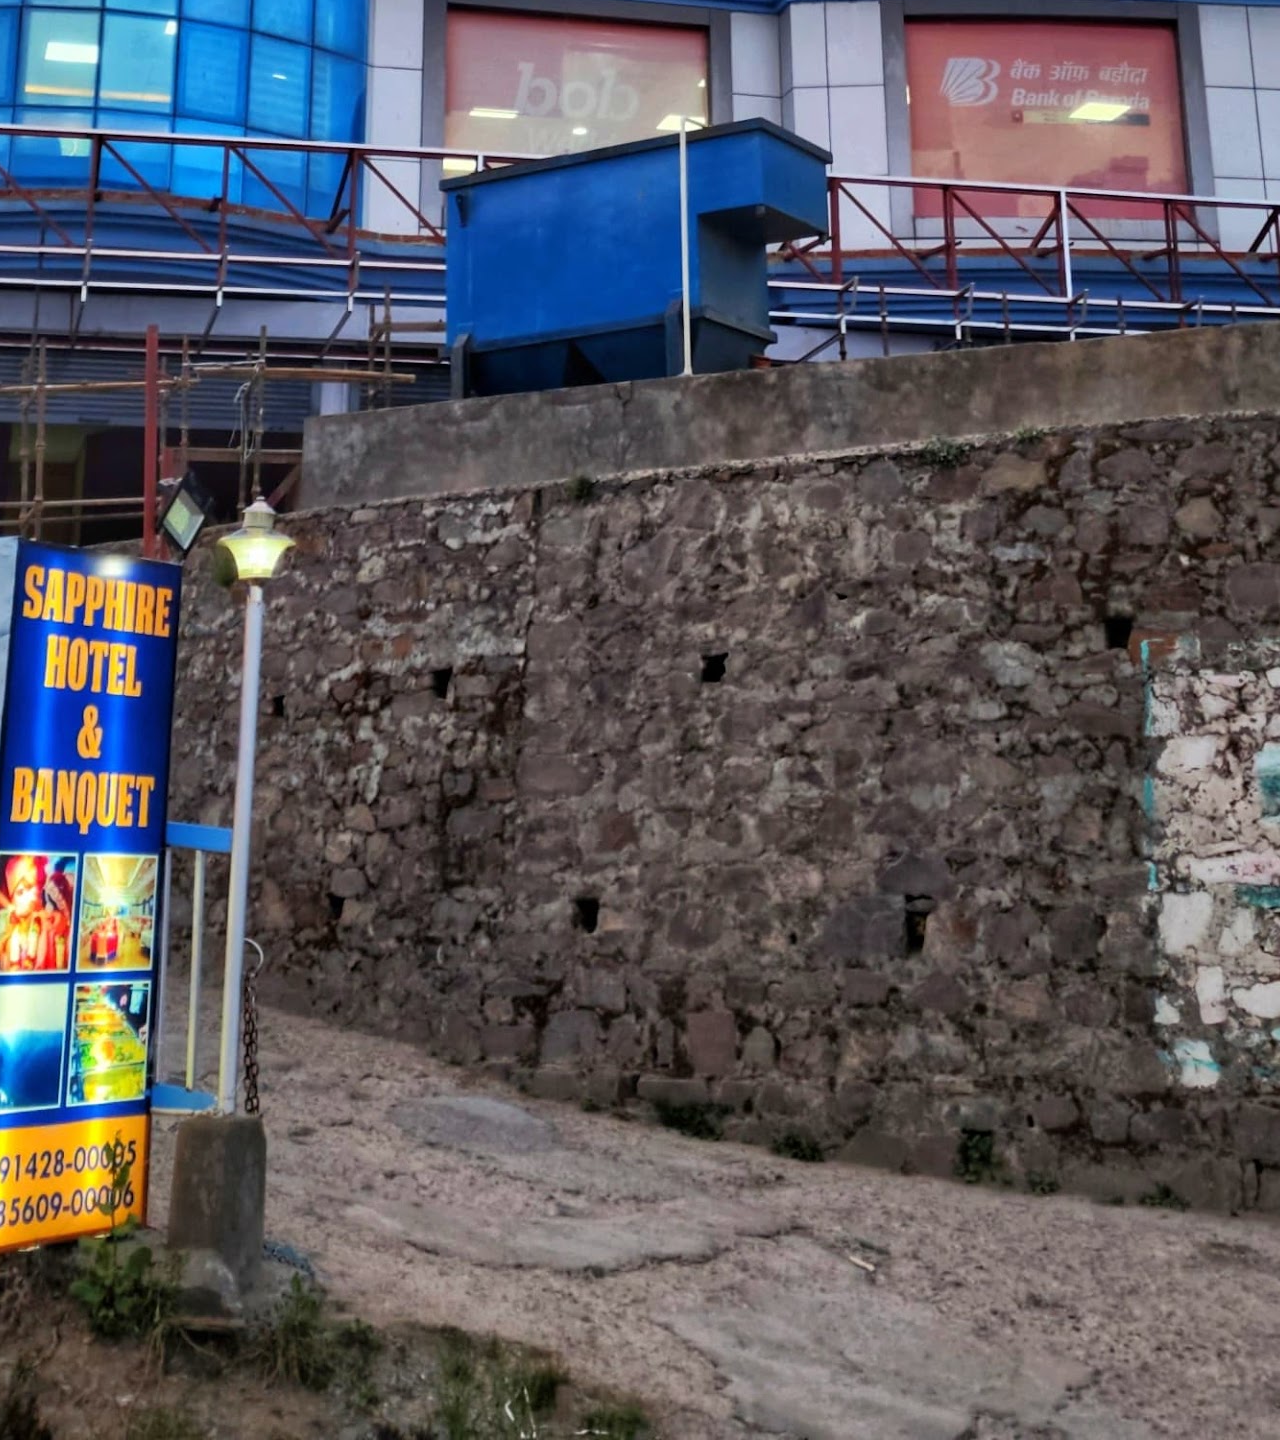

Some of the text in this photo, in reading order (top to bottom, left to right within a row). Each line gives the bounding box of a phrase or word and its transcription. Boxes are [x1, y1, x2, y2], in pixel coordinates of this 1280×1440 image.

[514, 60, 640, 122] bob
[1009, 57, 1041, 80] बैंक
[1011, 88, 1059, 106] Bank
[1062, 89, 1082, 106] of
[22, 564, 173, 638] SAPPHIRE
[44, 633, 142, 697] HOTEL
[76, 704, 103, 760] &
[9, 767, 156, 836] BANQUET
